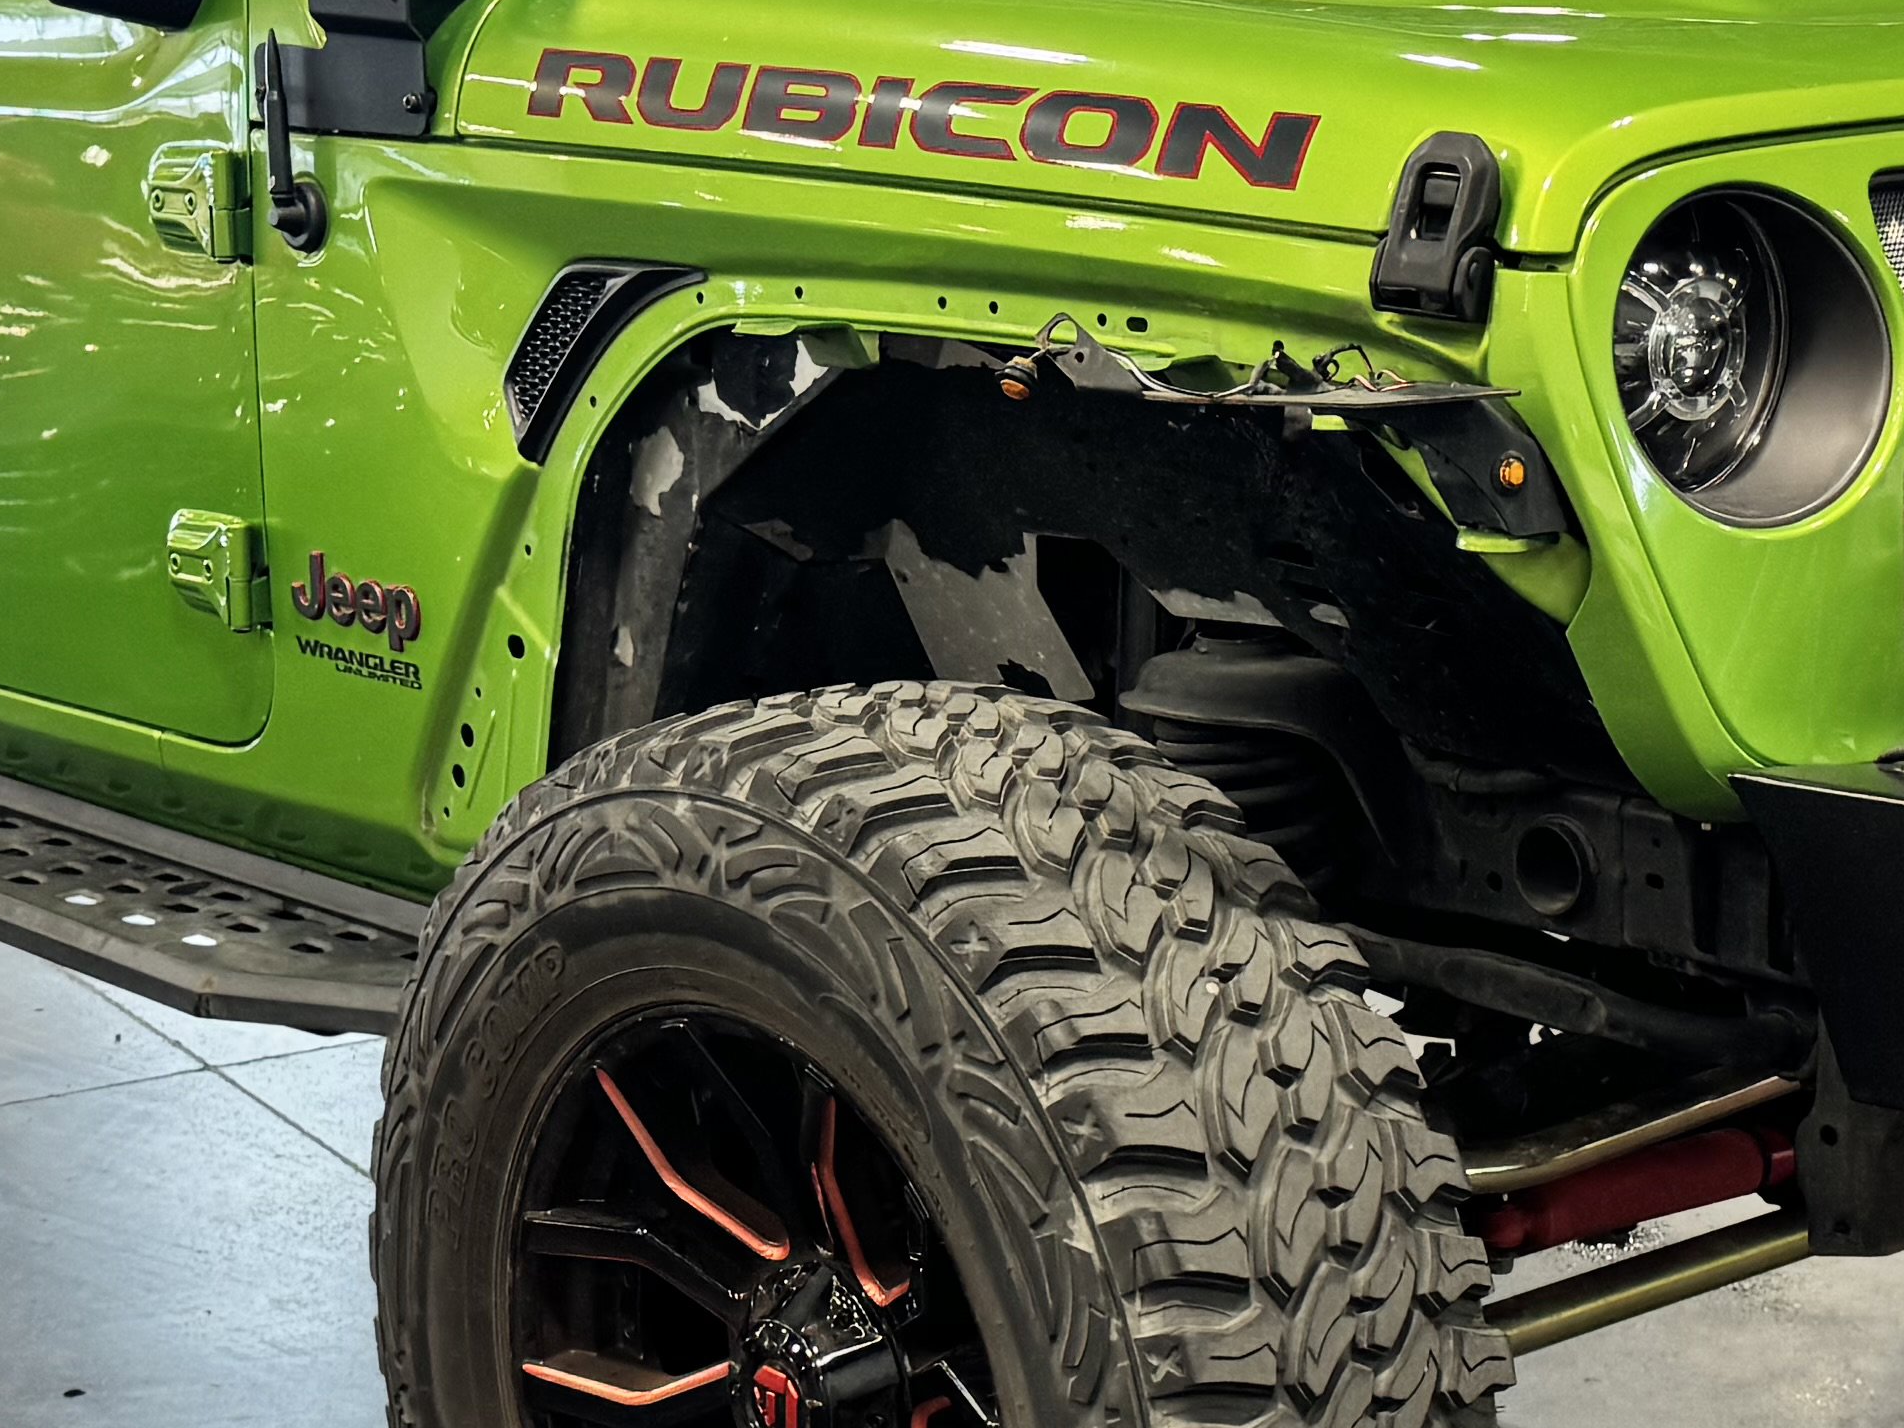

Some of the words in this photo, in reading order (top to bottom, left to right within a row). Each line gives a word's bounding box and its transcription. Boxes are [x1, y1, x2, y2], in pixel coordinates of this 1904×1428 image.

[527, 48, 1322, 190] RUBICON
[291, 550, 421, 653] Jeep
[296, 635, 421, 681] WRANGLER
[335, 663, 423, 690] UNLIMITED
